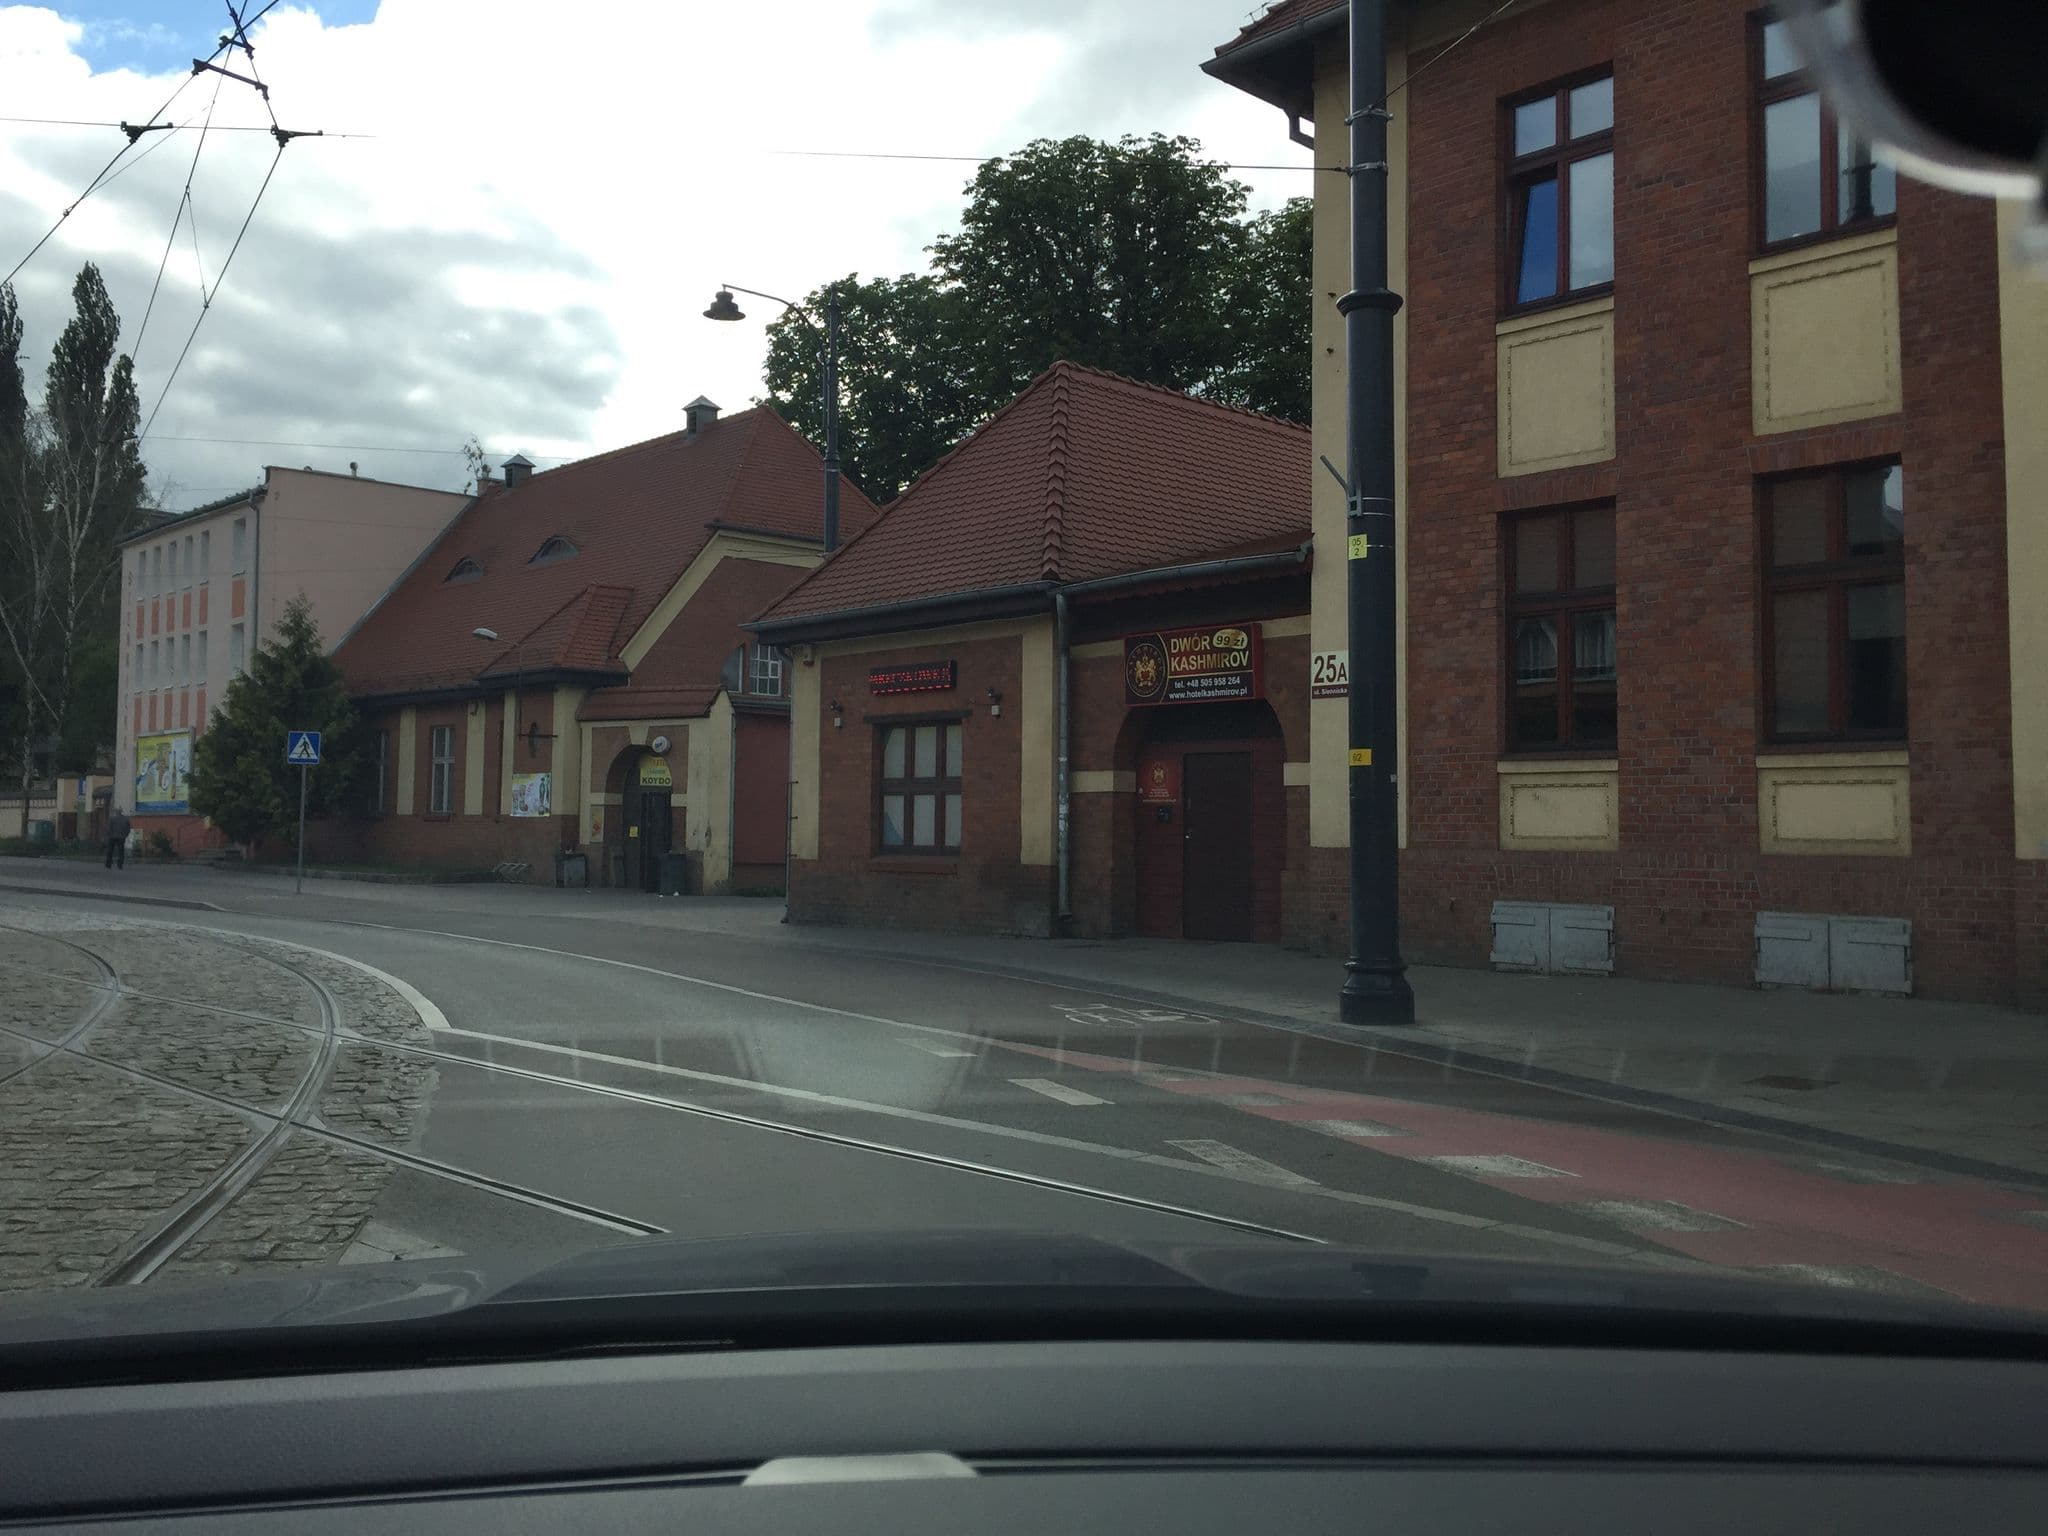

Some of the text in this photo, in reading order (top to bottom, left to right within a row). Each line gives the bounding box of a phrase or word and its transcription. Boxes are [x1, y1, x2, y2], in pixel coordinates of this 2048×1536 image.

[1170, 632, 1210, 653] DWÓR
[1216, 636, 1231, 646] 99
[1170, 651, 1249, 672] KASHMIROV
[1313, 654, 1348, 684] 25A
[1174, 680, 1185, 689] tel.
[1186, 678, 1199, 687] +48
[1200, 677, 1213, 686] 505
[1226, 675, 1241, 685] 264
[1168, 686, 1248, 700] www.hotelkashmirov.pl
